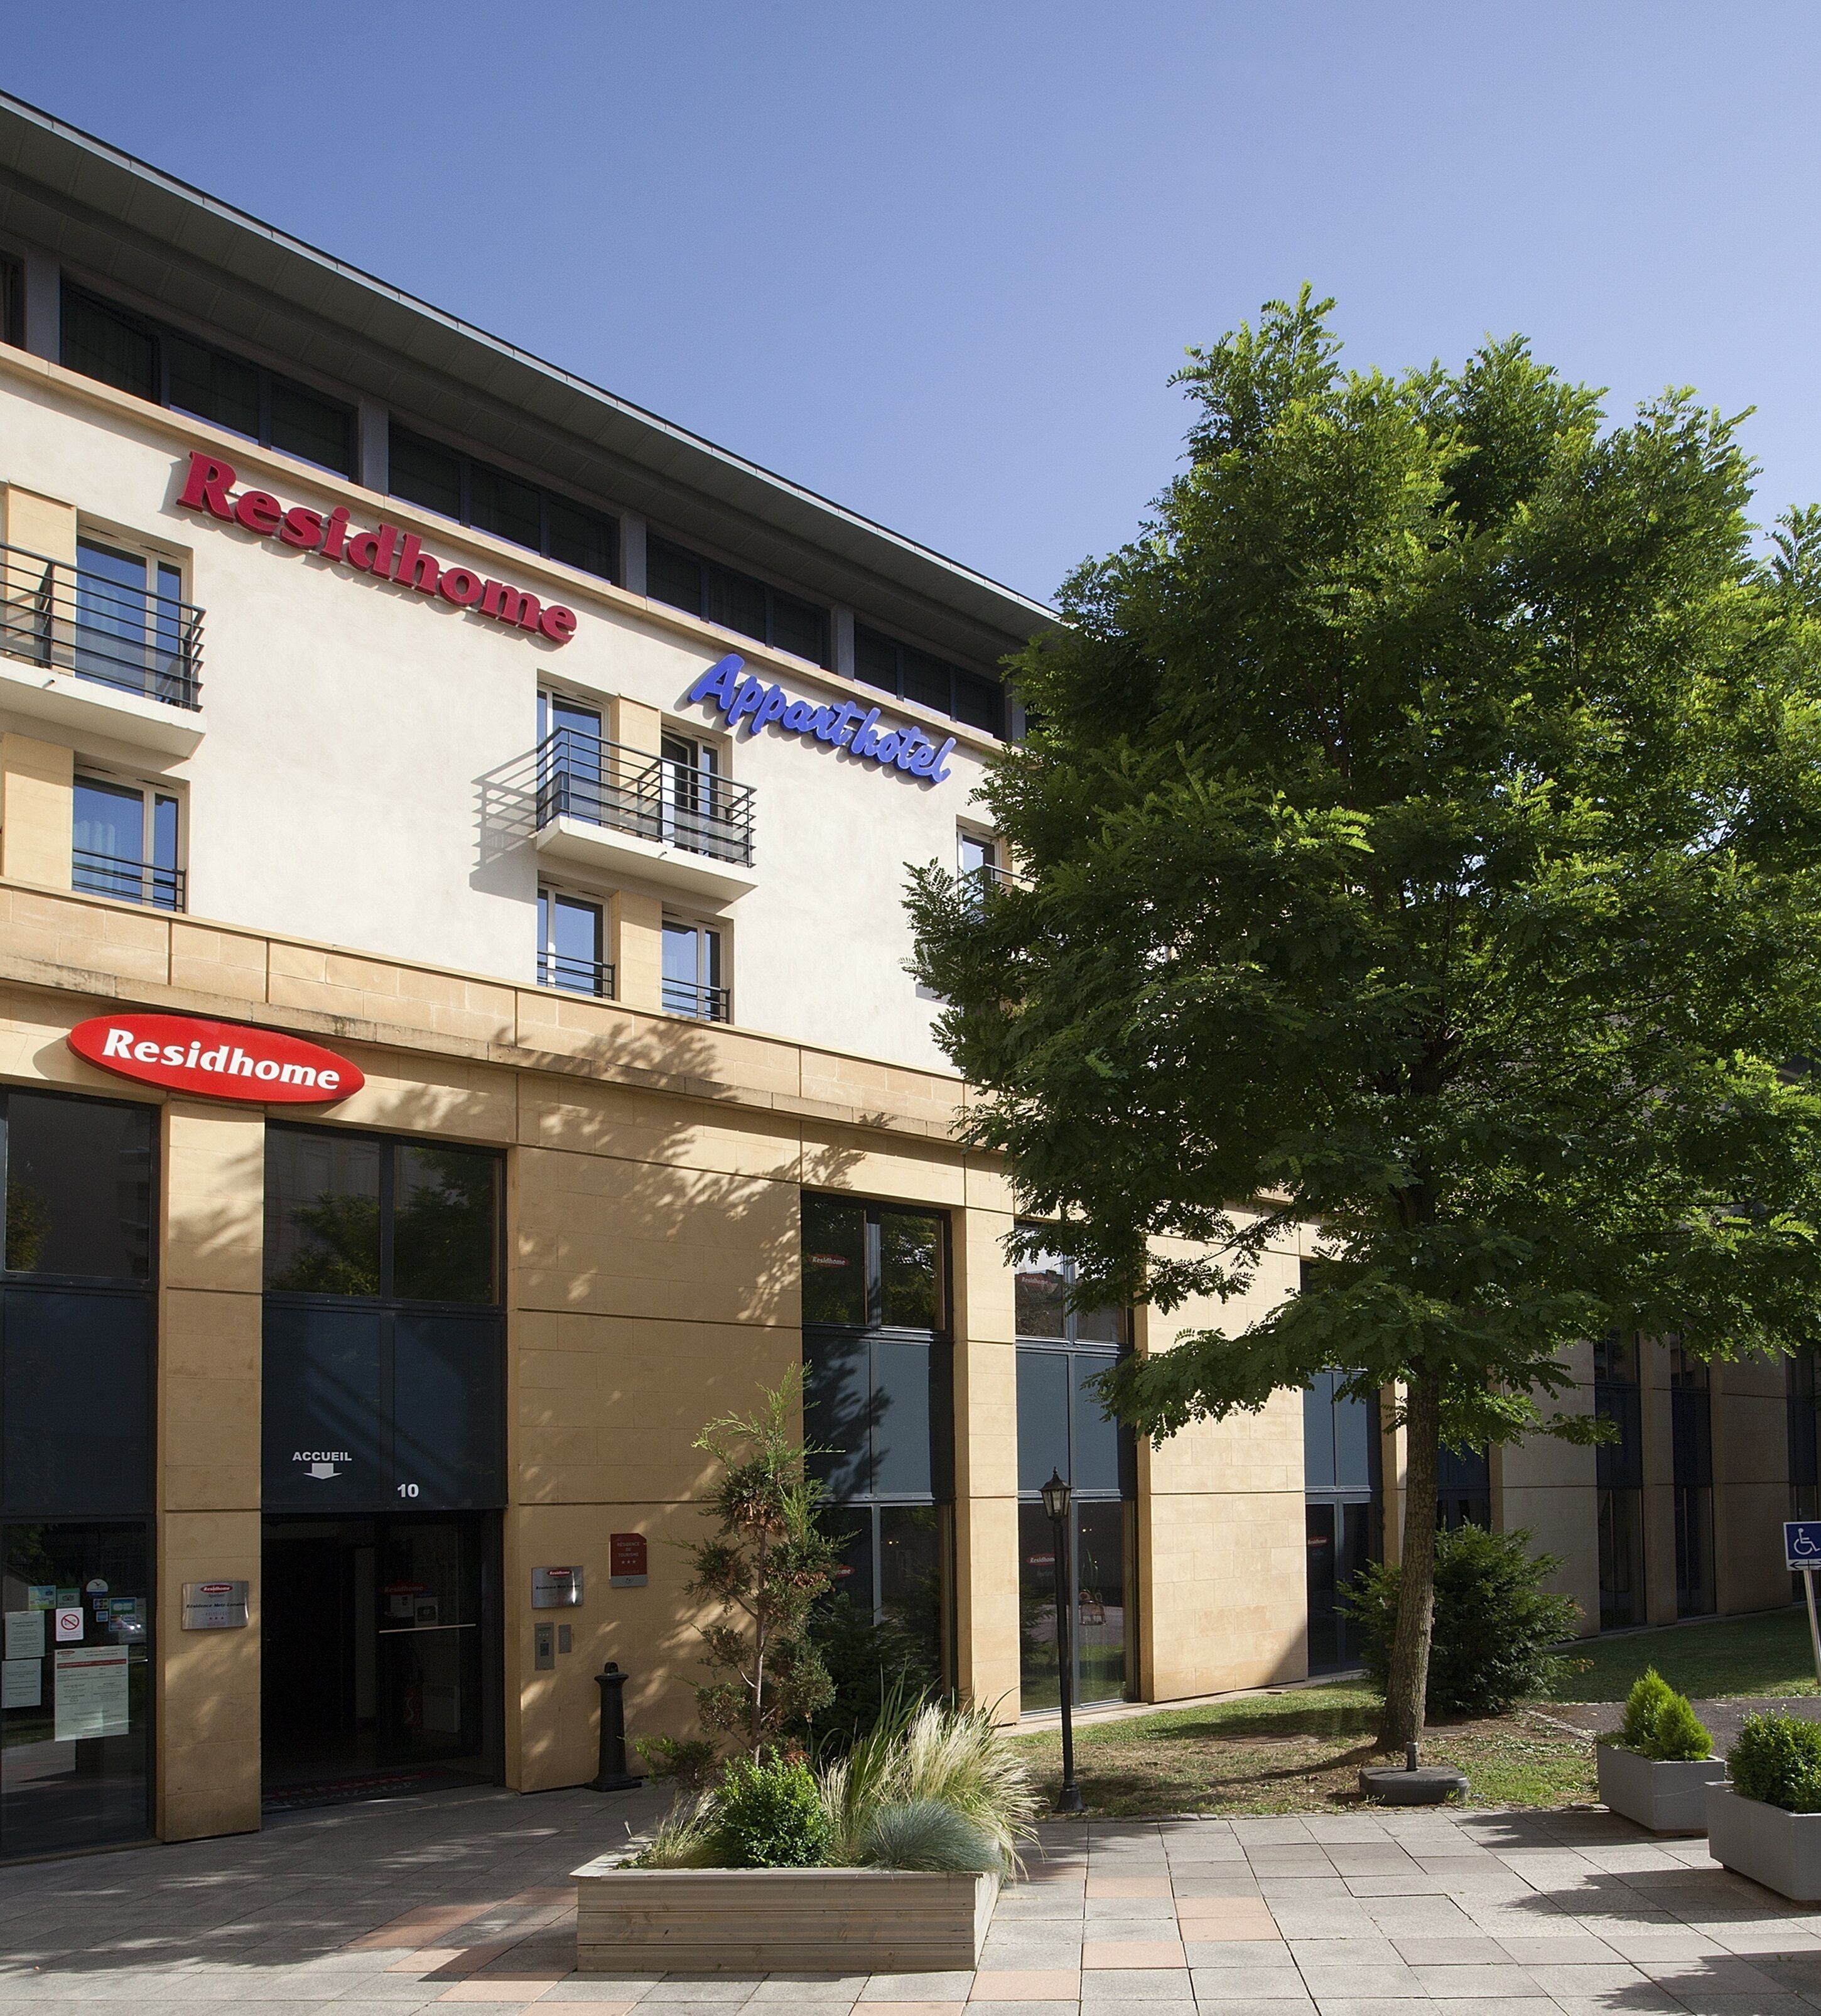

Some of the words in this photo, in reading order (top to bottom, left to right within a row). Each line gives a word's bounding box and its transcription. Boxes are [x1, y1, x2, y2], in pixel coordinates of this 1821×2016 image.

[176, 450, 577, 644] Residhome
[102, 1027, 340, 1090] Residhome
[813, 1256, 845, 1265] Residhome
[292, 1451, 352, 1461] ACCUEIL
[397, 1483, 419, 1498] 10
